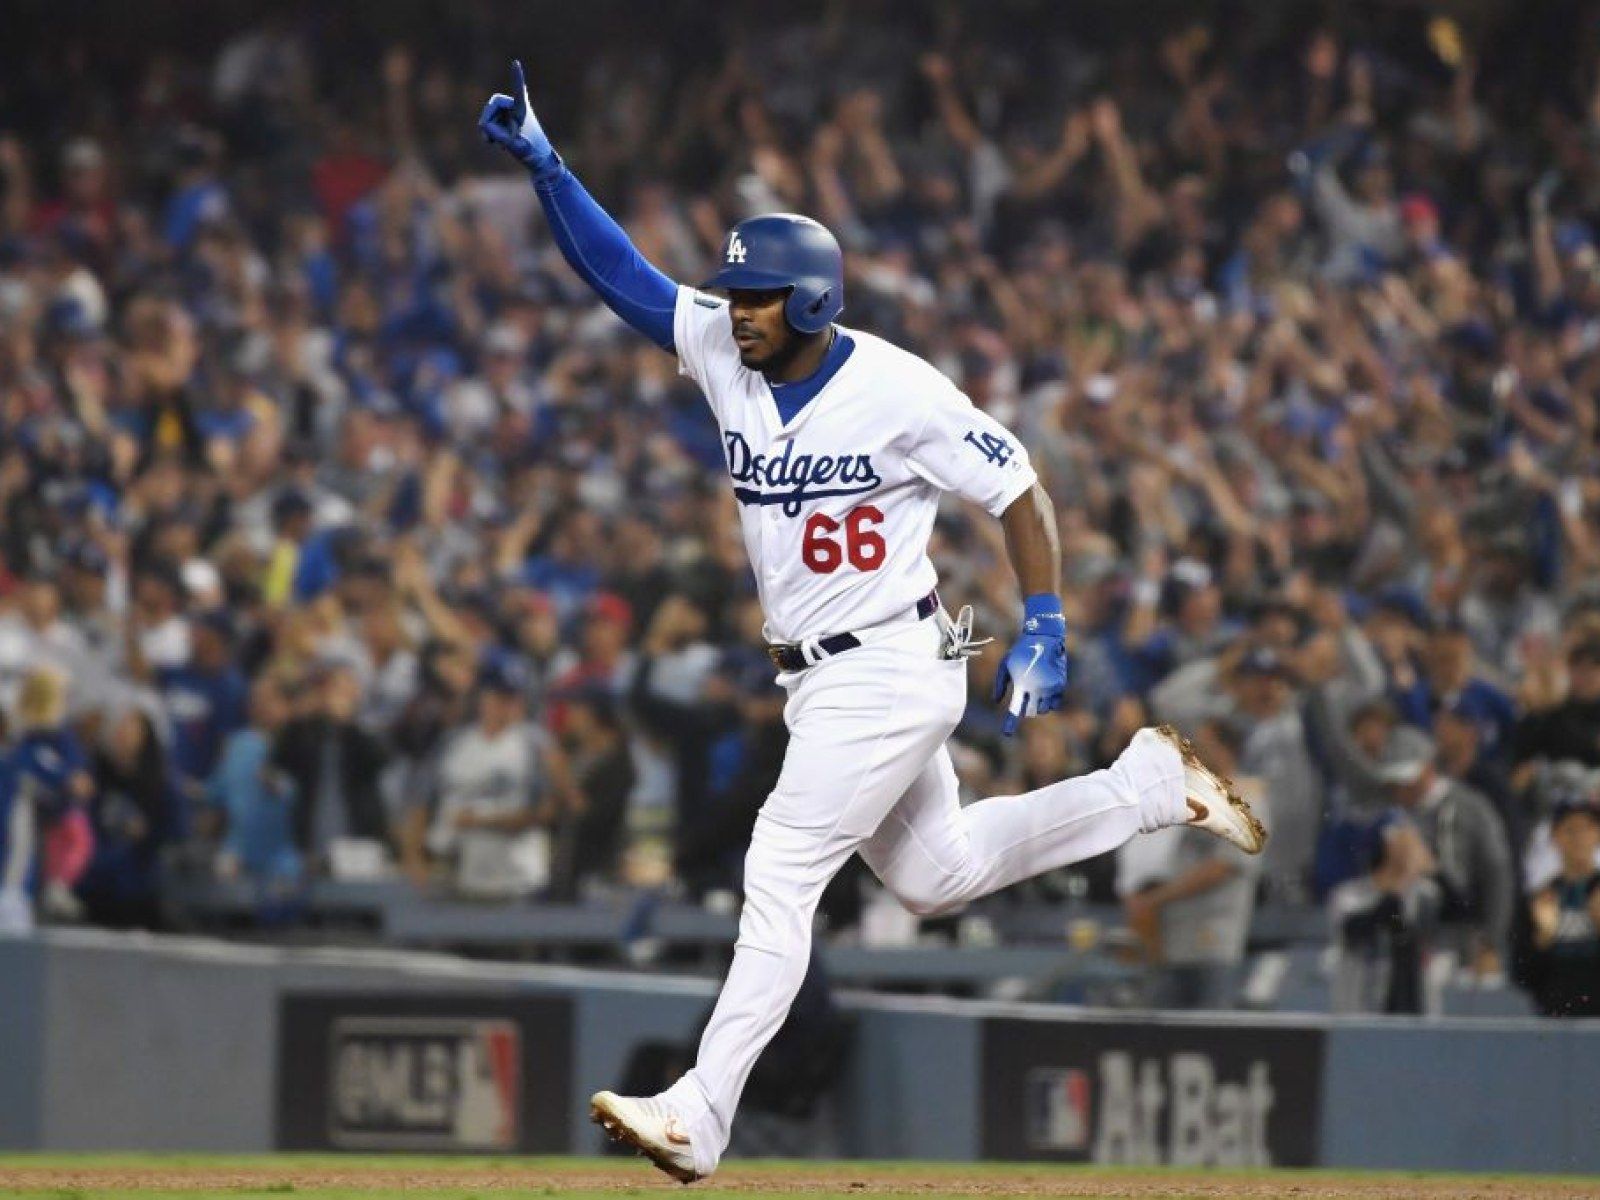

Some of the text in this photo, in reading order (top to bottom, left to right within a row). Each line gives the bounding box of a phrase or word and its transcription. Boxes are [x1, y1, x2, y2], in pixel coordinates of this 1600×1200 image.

[726, 231, 747, 263] LA
[724, 430, 881, 518] Dodgers
[963, 430, 1014, 467] LA
[802, 504, 886, 574] 66
